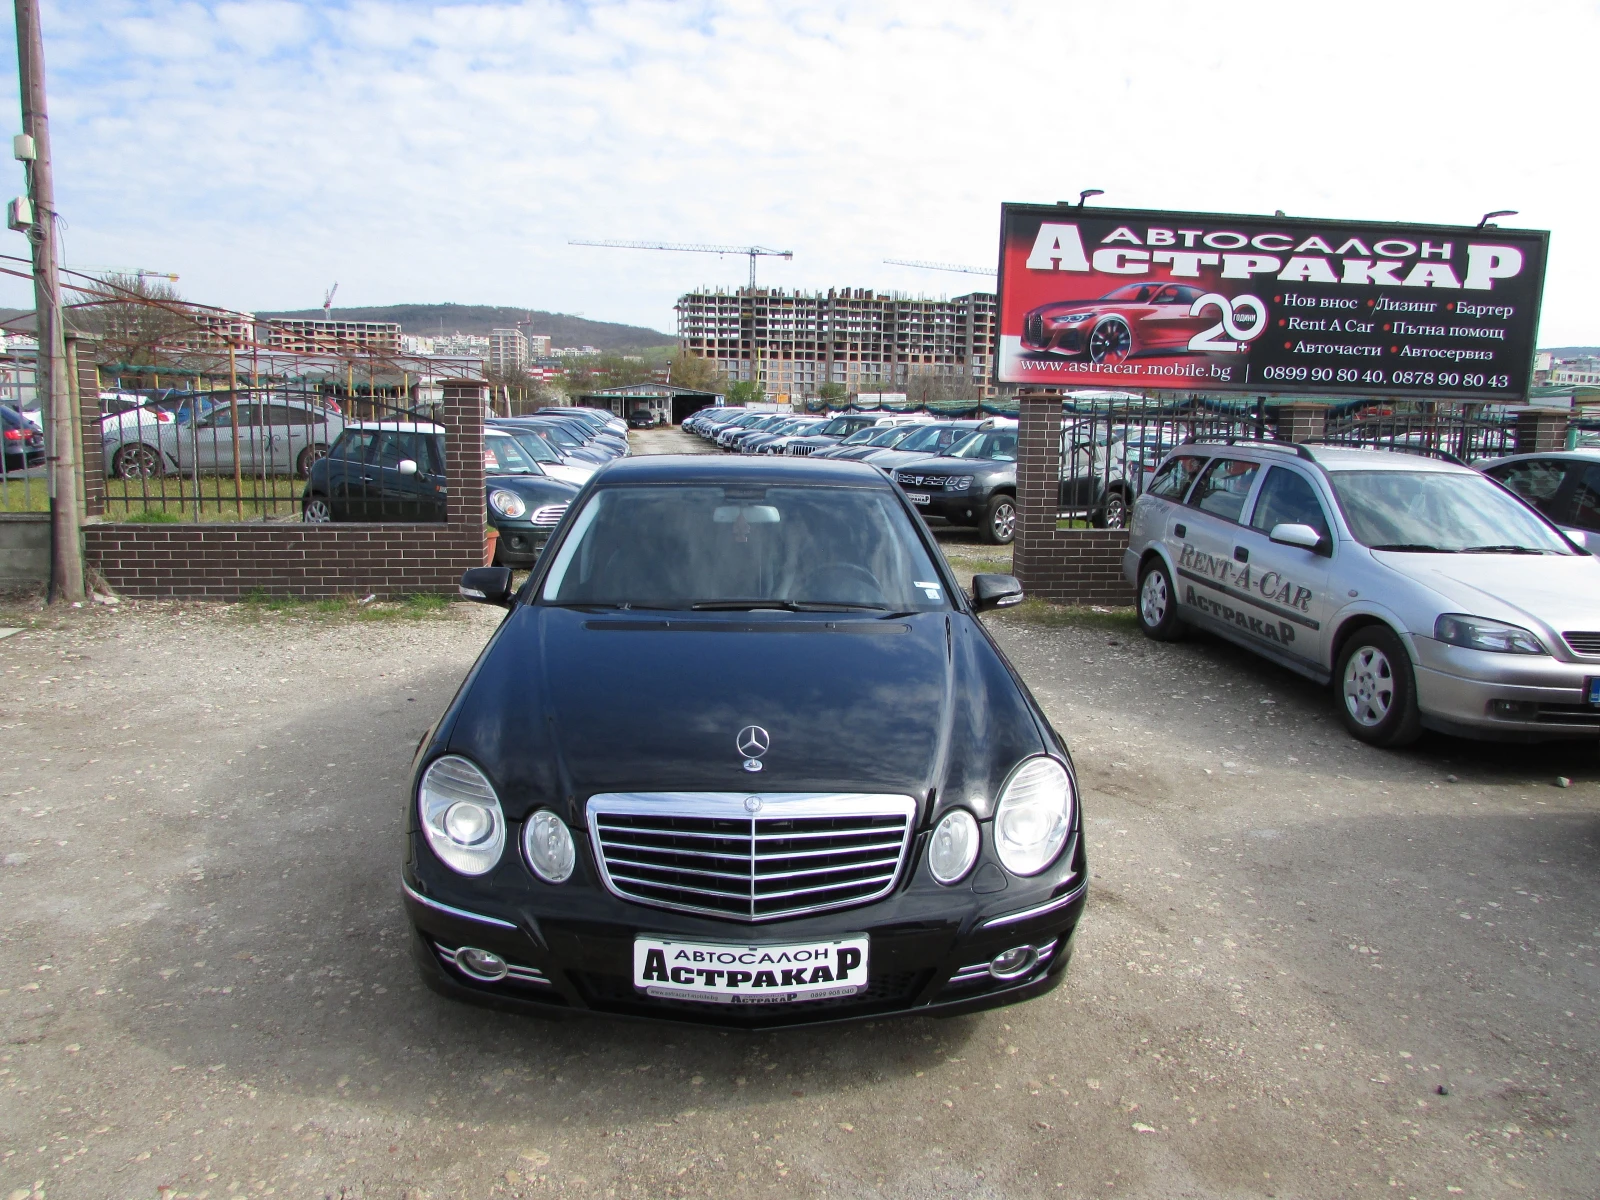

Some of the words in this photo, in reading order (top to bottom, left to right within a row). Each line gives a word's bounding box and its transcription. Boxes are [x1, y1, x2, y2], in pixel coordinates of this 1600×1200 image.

[1100, 227, 1452, 259] АВТОСАЛОН
[1283, 293, 1316, 308] Нов
[1319, 297, 1358, 309] внос
[1375, 297, 1438, 313] Лизинг
[1455, 301, 1514, 320] Бартер
[1287, 316, 1326, 331] Rent
[1328, 319, 1342, 332] A
[1344, 319, 1375, 333] Car
[1391, 321, 1445, 336] Пътна
[1448, 326, 1505, 341] помощ
[1293, 340, 1382, 357] Авточасти
[1399, 344, 1494, 362] Автосервиз
[1020, 359, 1232, 382] www.astracar.mobile.bg
[1263, 365, 1308, 380] 0899
[1311, 367, 1333, 381] 90
[1336, 368, 1358, 382] 80
[1392, 370, 1434, 385] 0878
[1438, 372, 1459, 386] 90
[1462, 373, 1484, 387] 80
[1487, 374, 1508, 388] 43
[674, 947, 829, 964] АВТОСАЛОН
